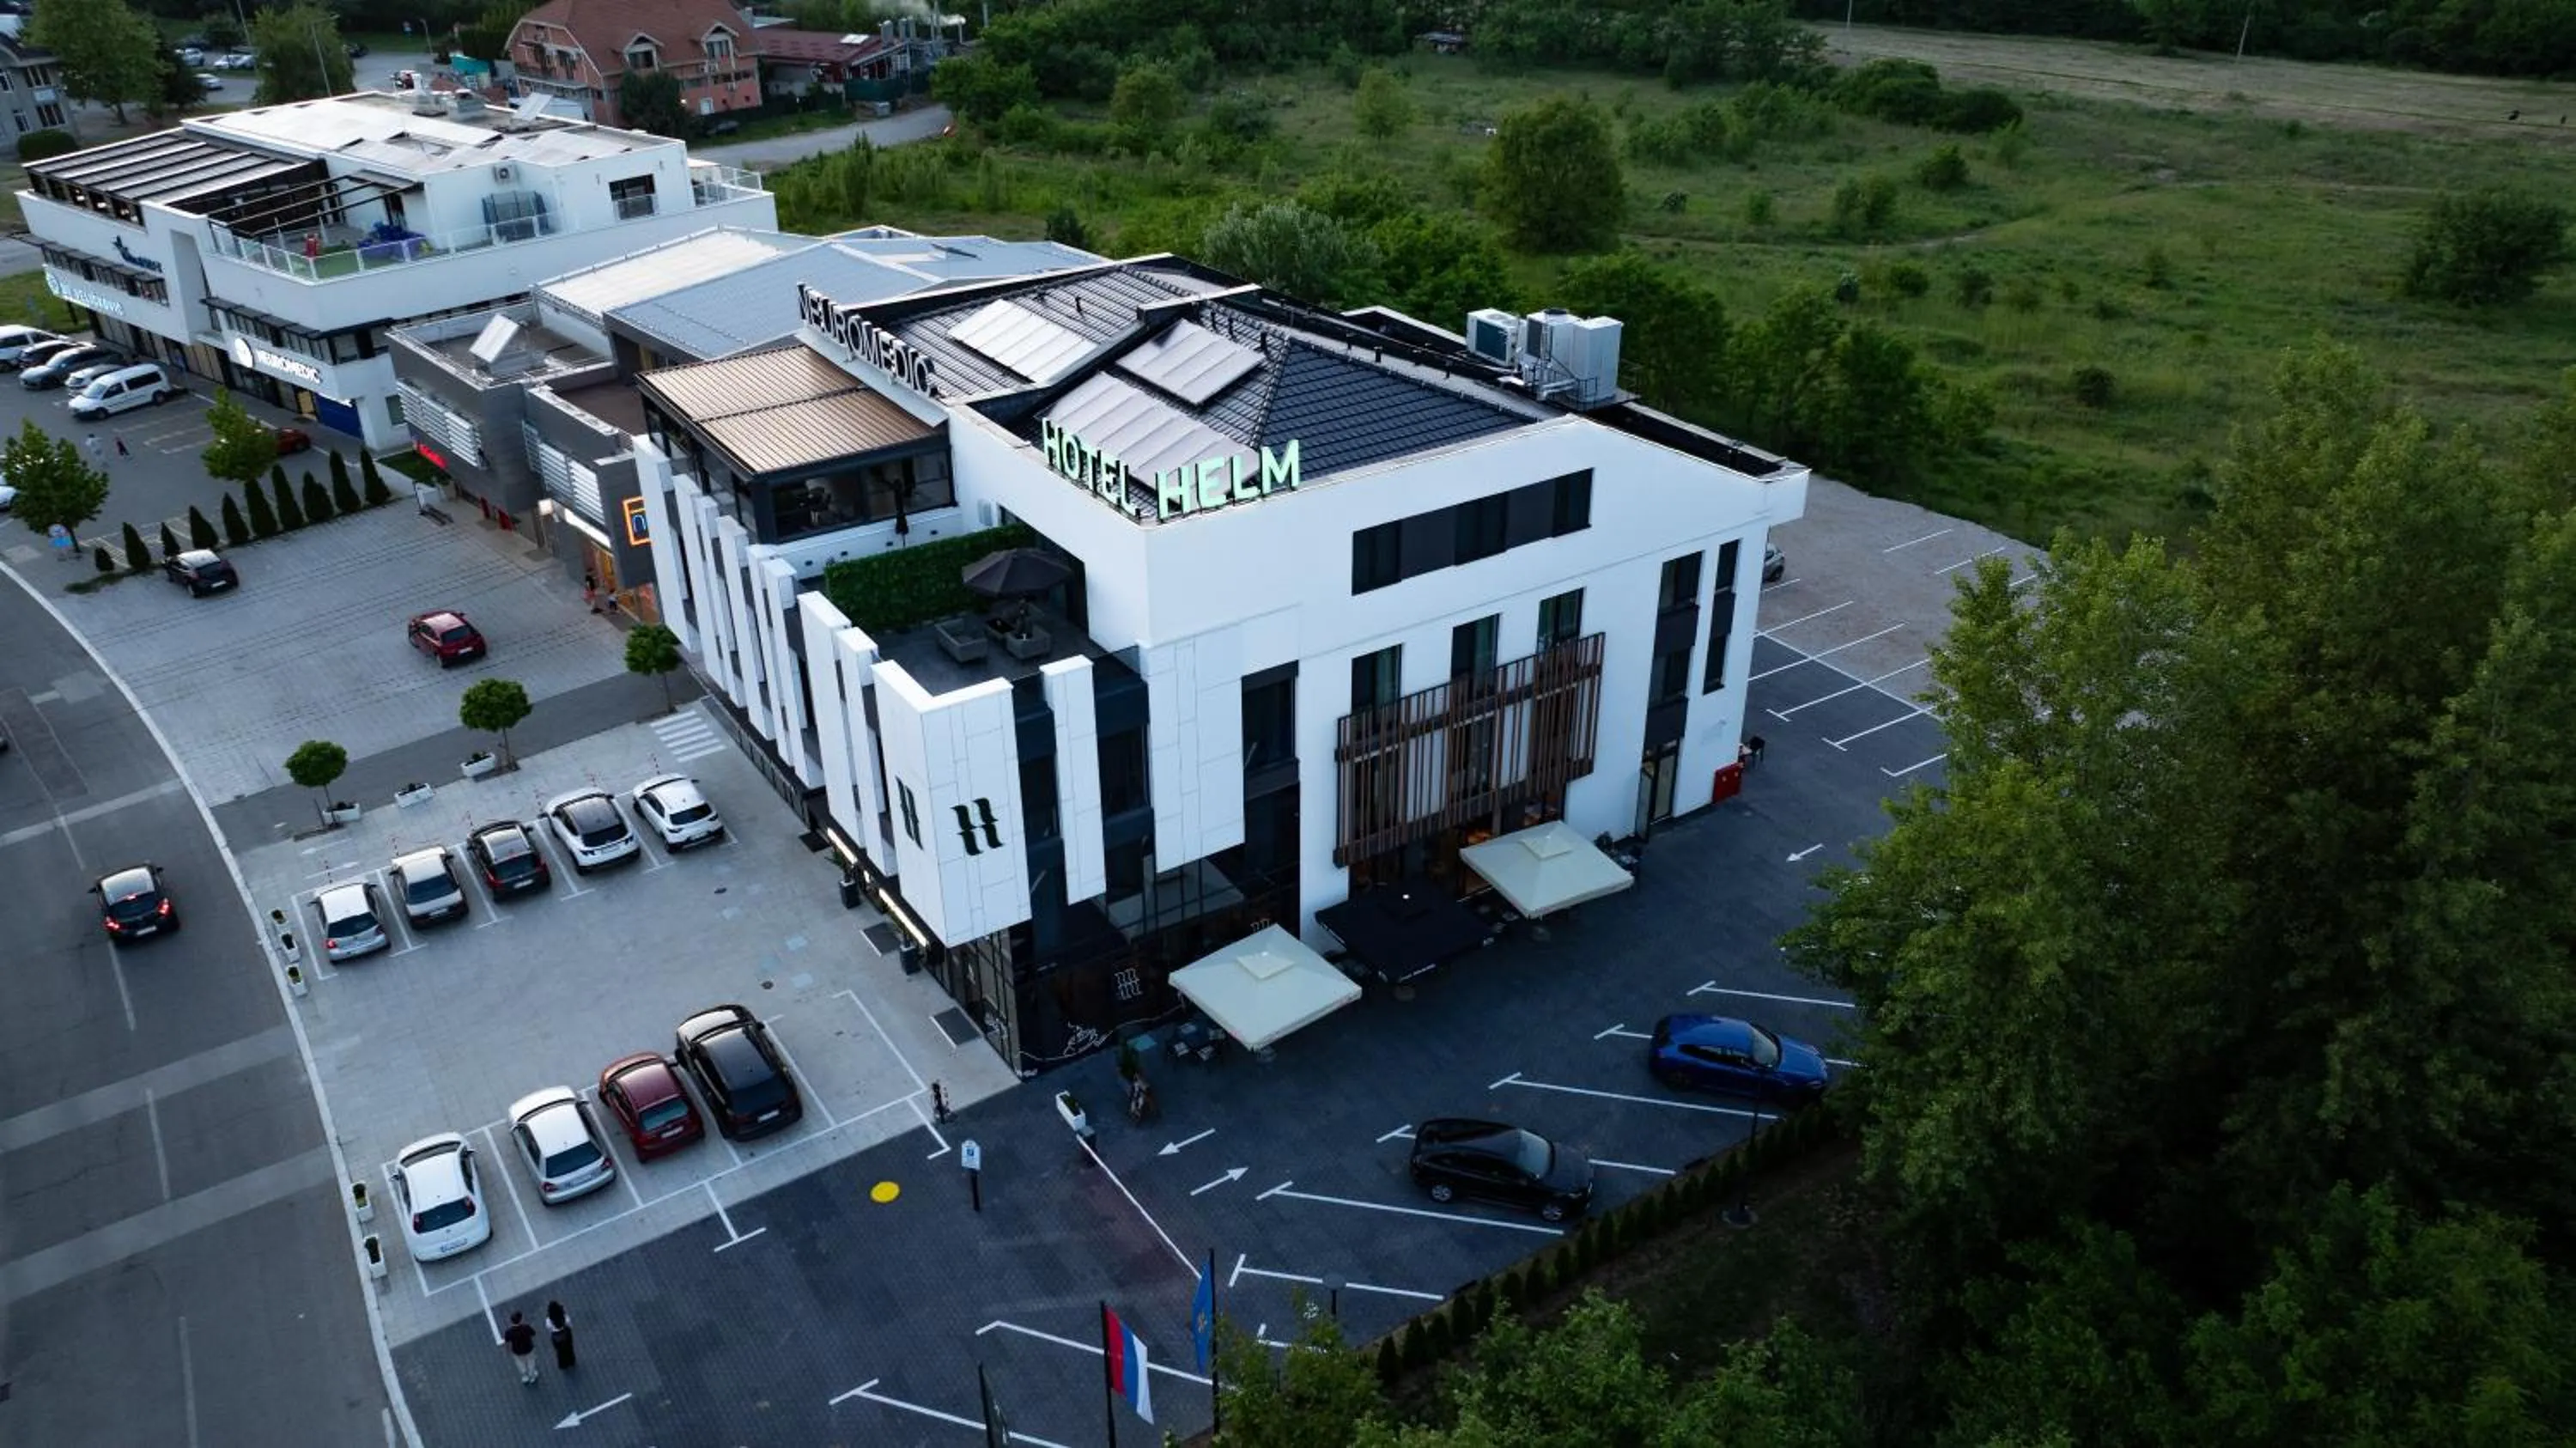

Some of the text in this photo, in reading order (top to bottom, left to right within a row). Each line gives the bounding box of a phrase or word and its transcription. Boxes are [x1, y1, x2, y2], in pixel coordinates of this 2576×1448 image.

[797, 282, 938, 400] NEUROMEDIC
[1042, 417, 1301, 520] HOTEL HELM
